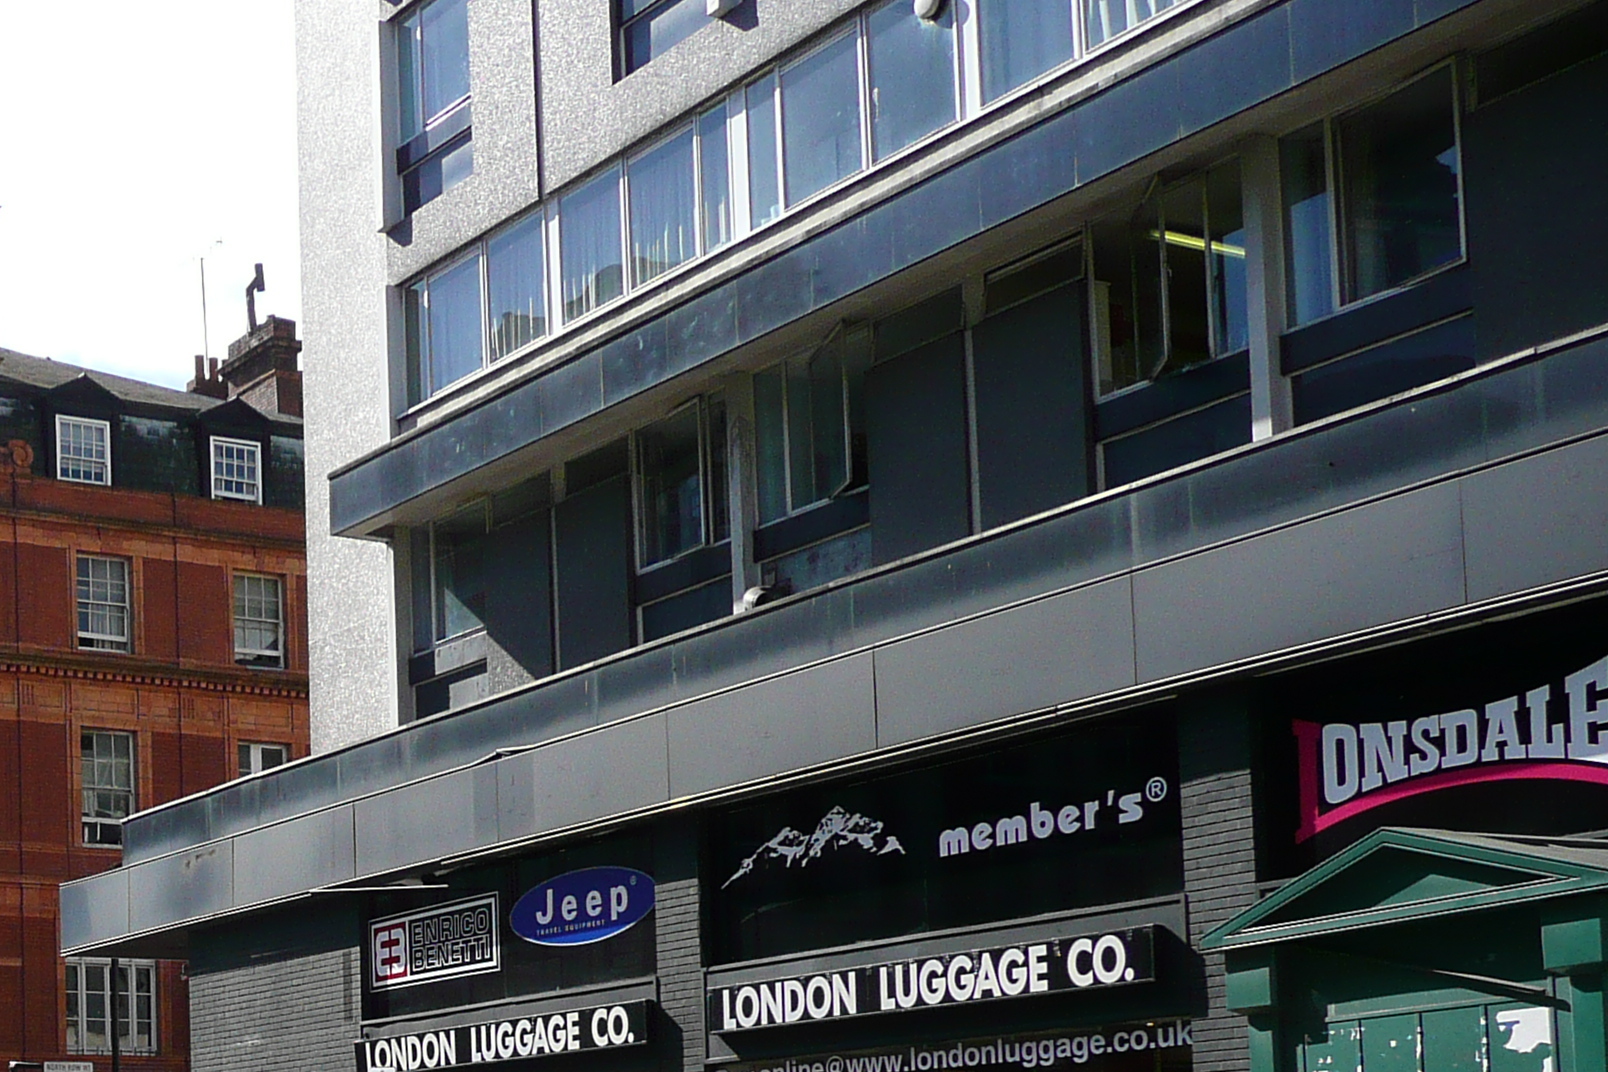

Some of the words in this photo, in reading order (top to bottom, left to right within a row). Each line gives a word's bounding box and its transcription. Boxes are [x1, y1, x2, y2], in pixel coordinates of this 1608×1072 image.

[1293, 656, 1608, 845] LONSDALE
[412, 908, 489, 947] ENRICO
[412, 934, 490, 972] BENETTI
[536, 926, 561, 936] TRAVEL
[565, 920, 605, 931] EQUIPMENT
[722, 971, 857, 1031] LONDON
[879, 944, 1049, 1010] LUGGAGE
[1067, 934, 1135, 987] CO.
[365, 1031, 456, 1072] LONDON
[471, 1012, 579, 1062] LUGGAGE
[591, 1006, 634, 1046] CO.
